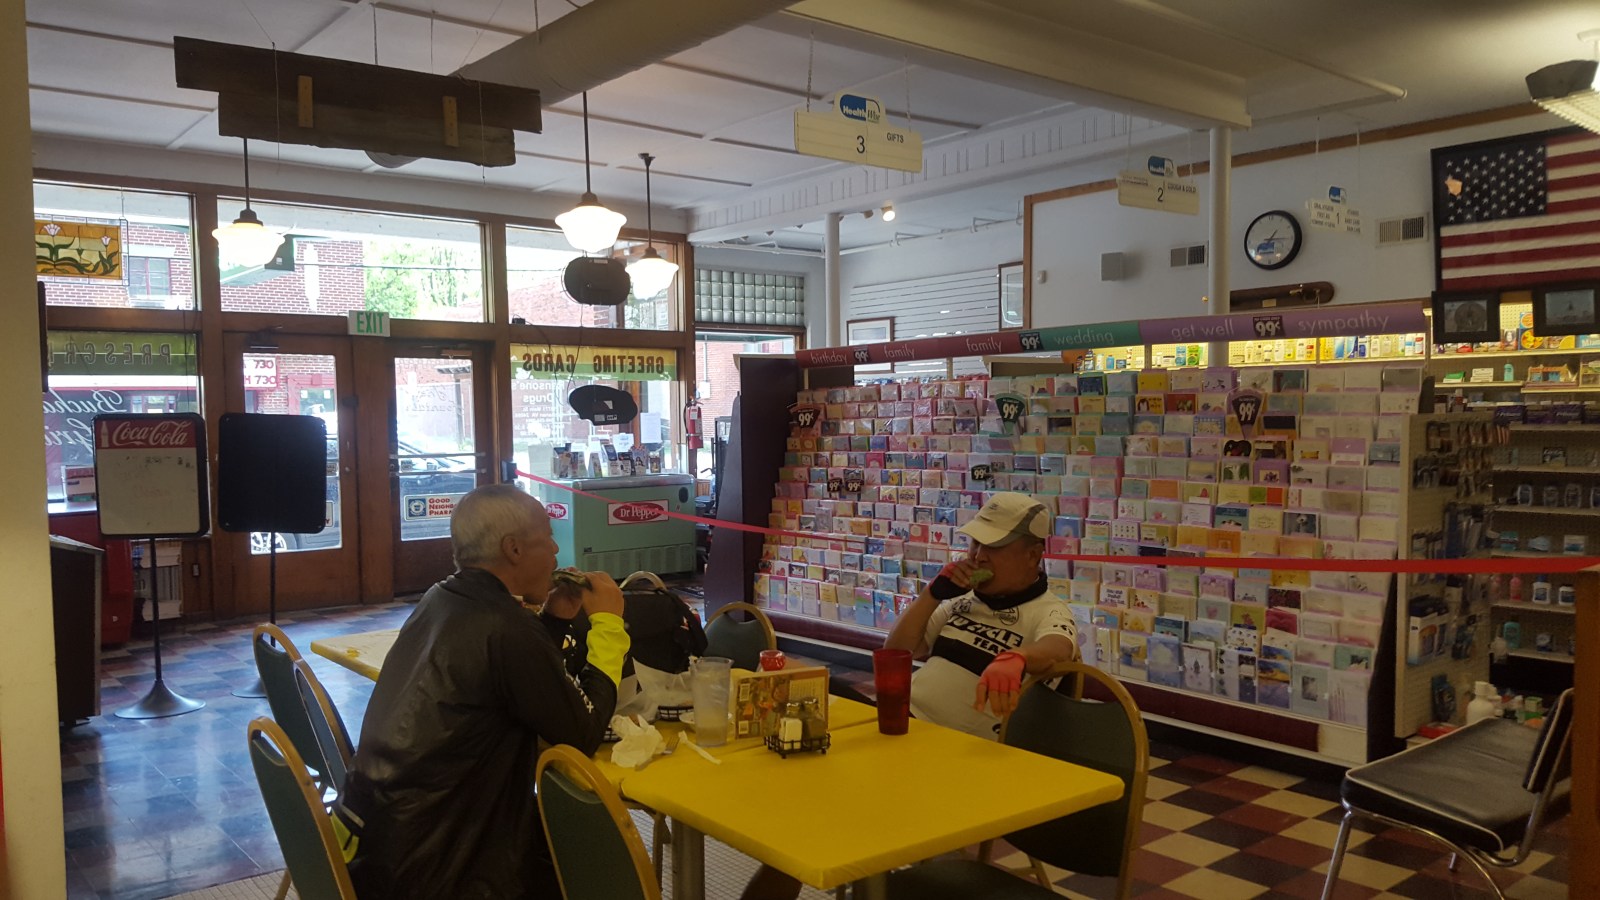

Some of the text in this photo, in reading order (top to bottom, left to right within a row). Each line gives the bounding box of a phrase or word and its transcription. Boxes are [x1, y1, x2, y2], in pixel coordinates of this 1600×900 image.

[842, 105, 866, 118] Health
[856, 135, 866, 154] 3
[886, 132, 904, 144] GIFTS
[1157, 187, 1164, 203] 2
[1186, 186, 1196, 194] COLD
[1336, 212, 1340, 224] 1
[356, 312, 384, 334] EXIT
[1298, 309, 1390, 333] sympathy
[1054, 328, 1114, 345] wedding
[1171, 319, 1234, 341] get well
[884, 343, 916, 358] family
[966, 336, 1002, 353] family
[254, 359, 274, 369] 730
[810, 350, 848, 365] birthday
[254, 375, 277, 385] 730
[112, 420, 192, 447] Coca-Cola
[552, 505, 564, 518] Pepper
[620, 504, 658, 520] Dr Pepper
[973, 636, 1008, 654] TEA
